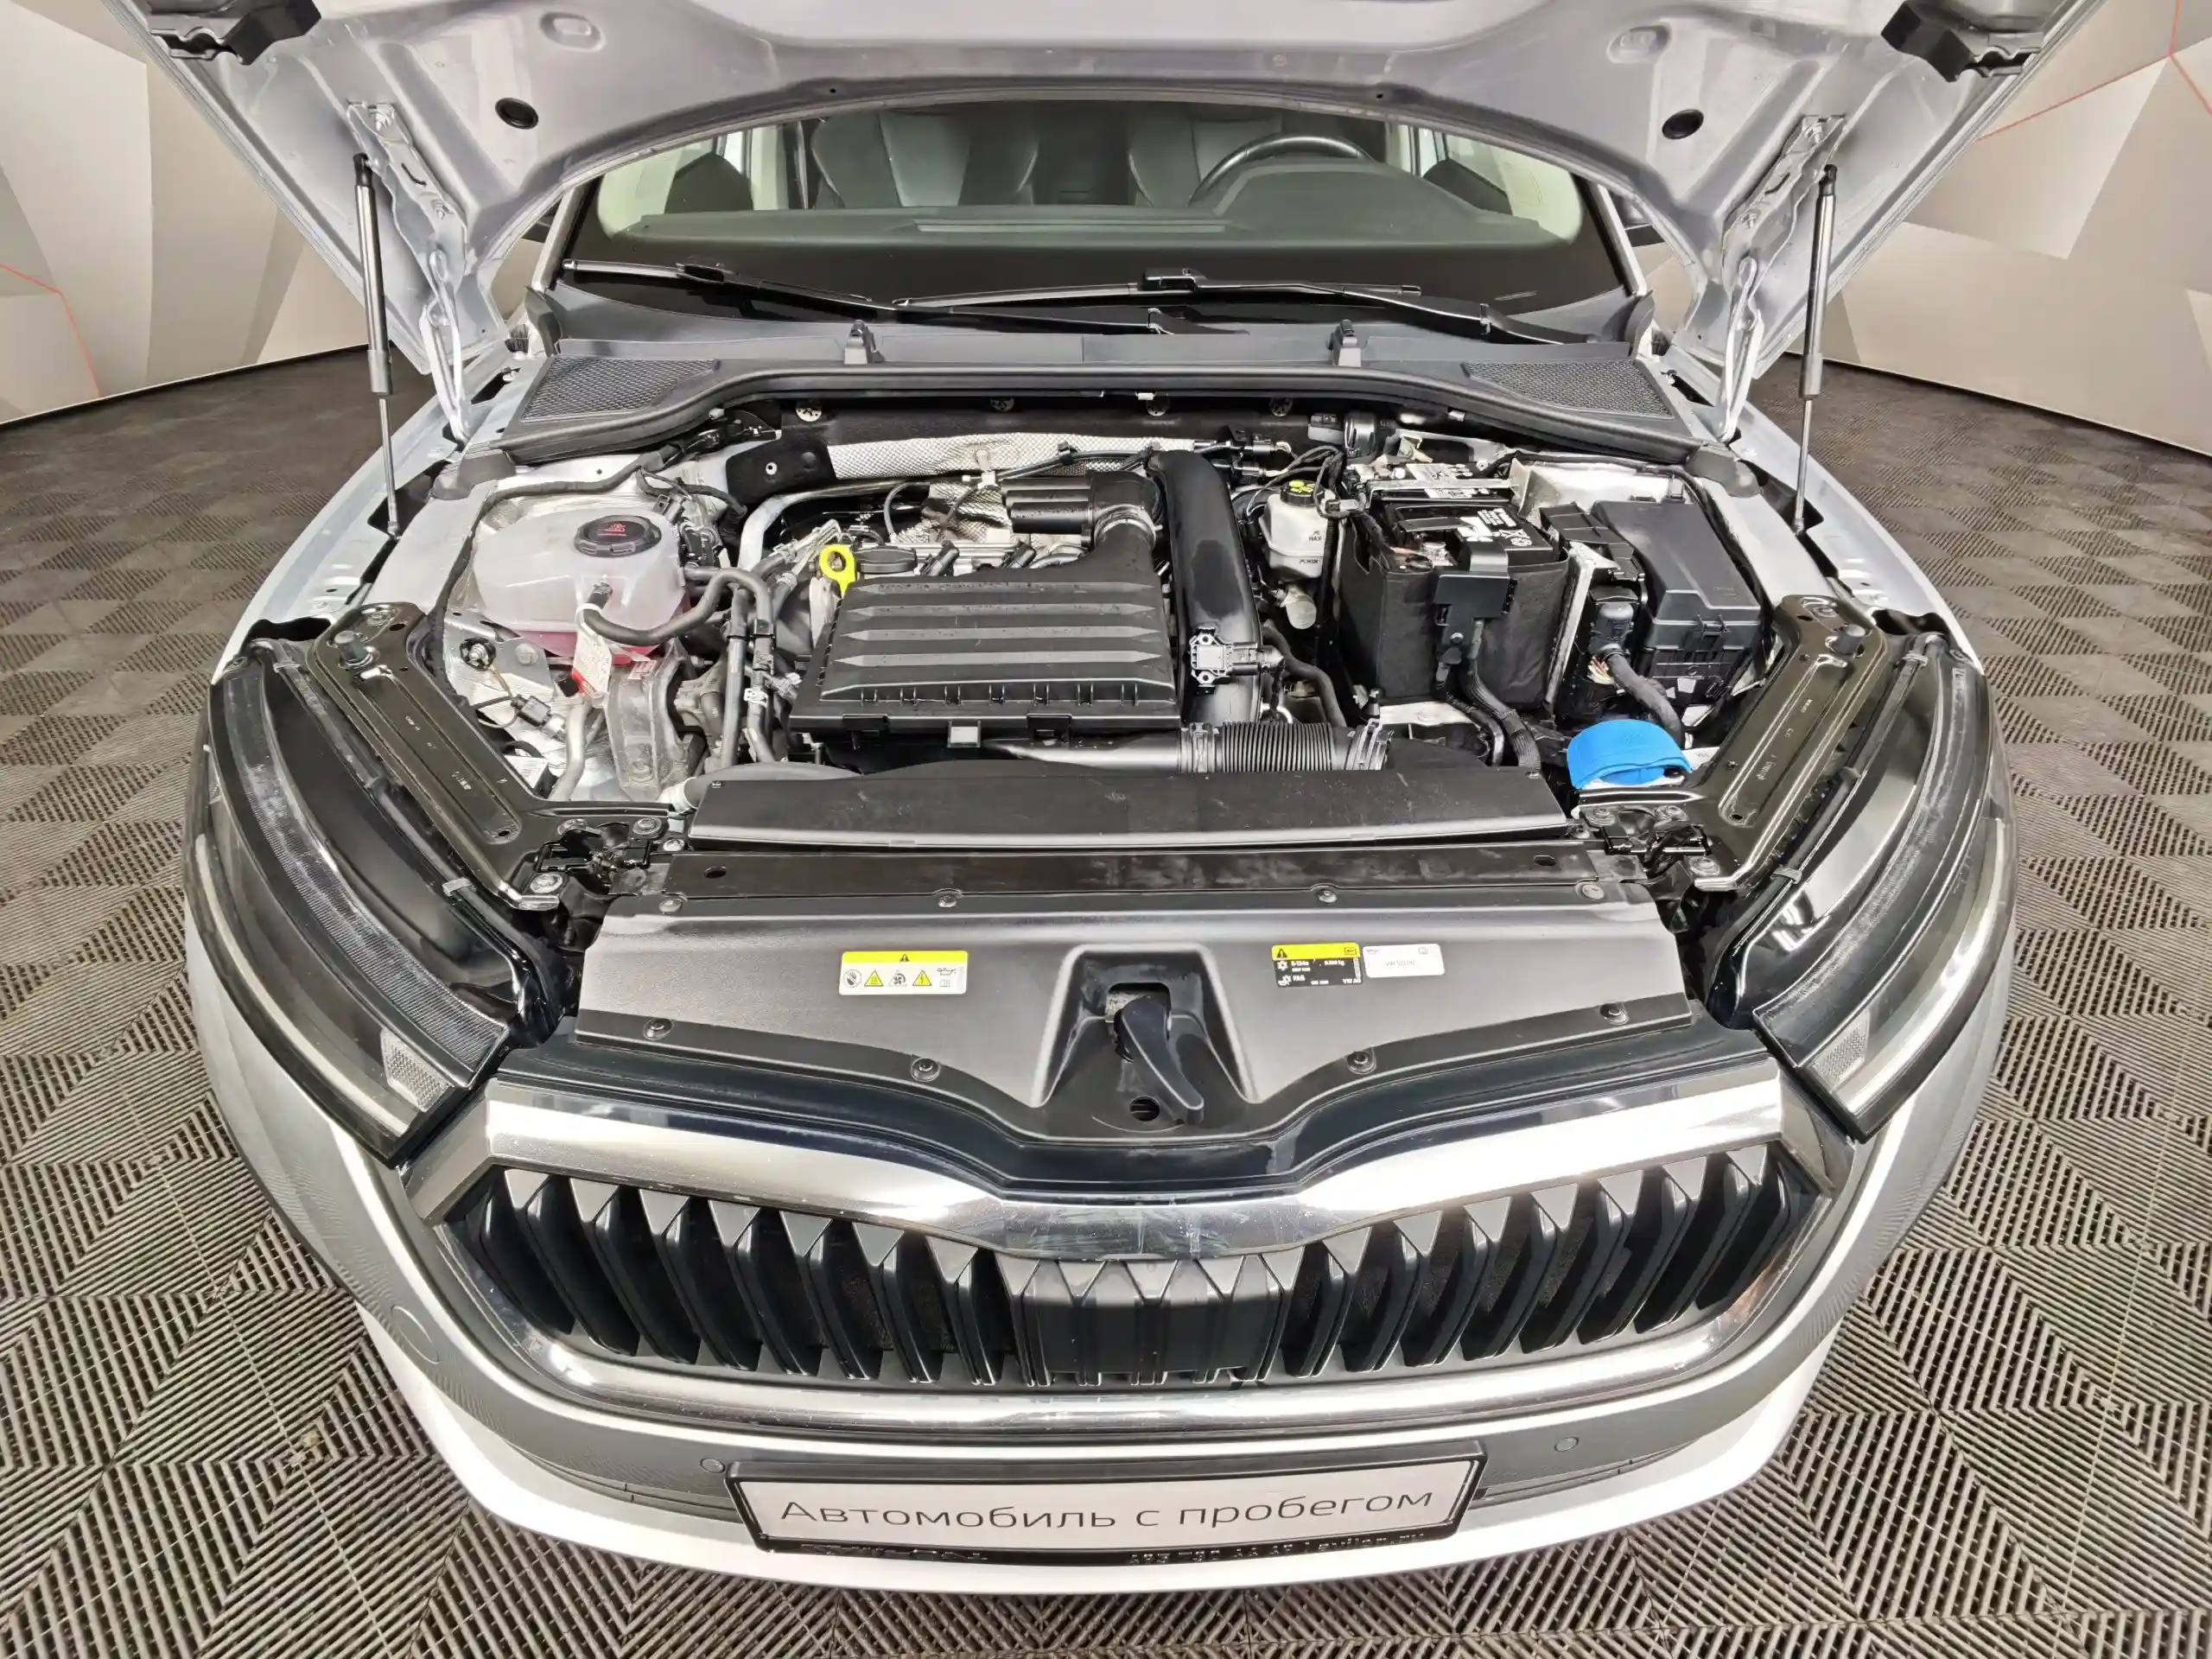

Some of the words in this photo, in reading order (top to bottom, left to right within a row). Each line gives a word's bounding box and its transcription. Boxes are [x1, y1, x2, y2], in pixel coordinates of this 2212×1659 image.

[780, 1501, 1116, 1529] Автомобиль
[1135, 1510, 1160, 1527] с
[1179, 1491, 1433, 1529] пробегом
